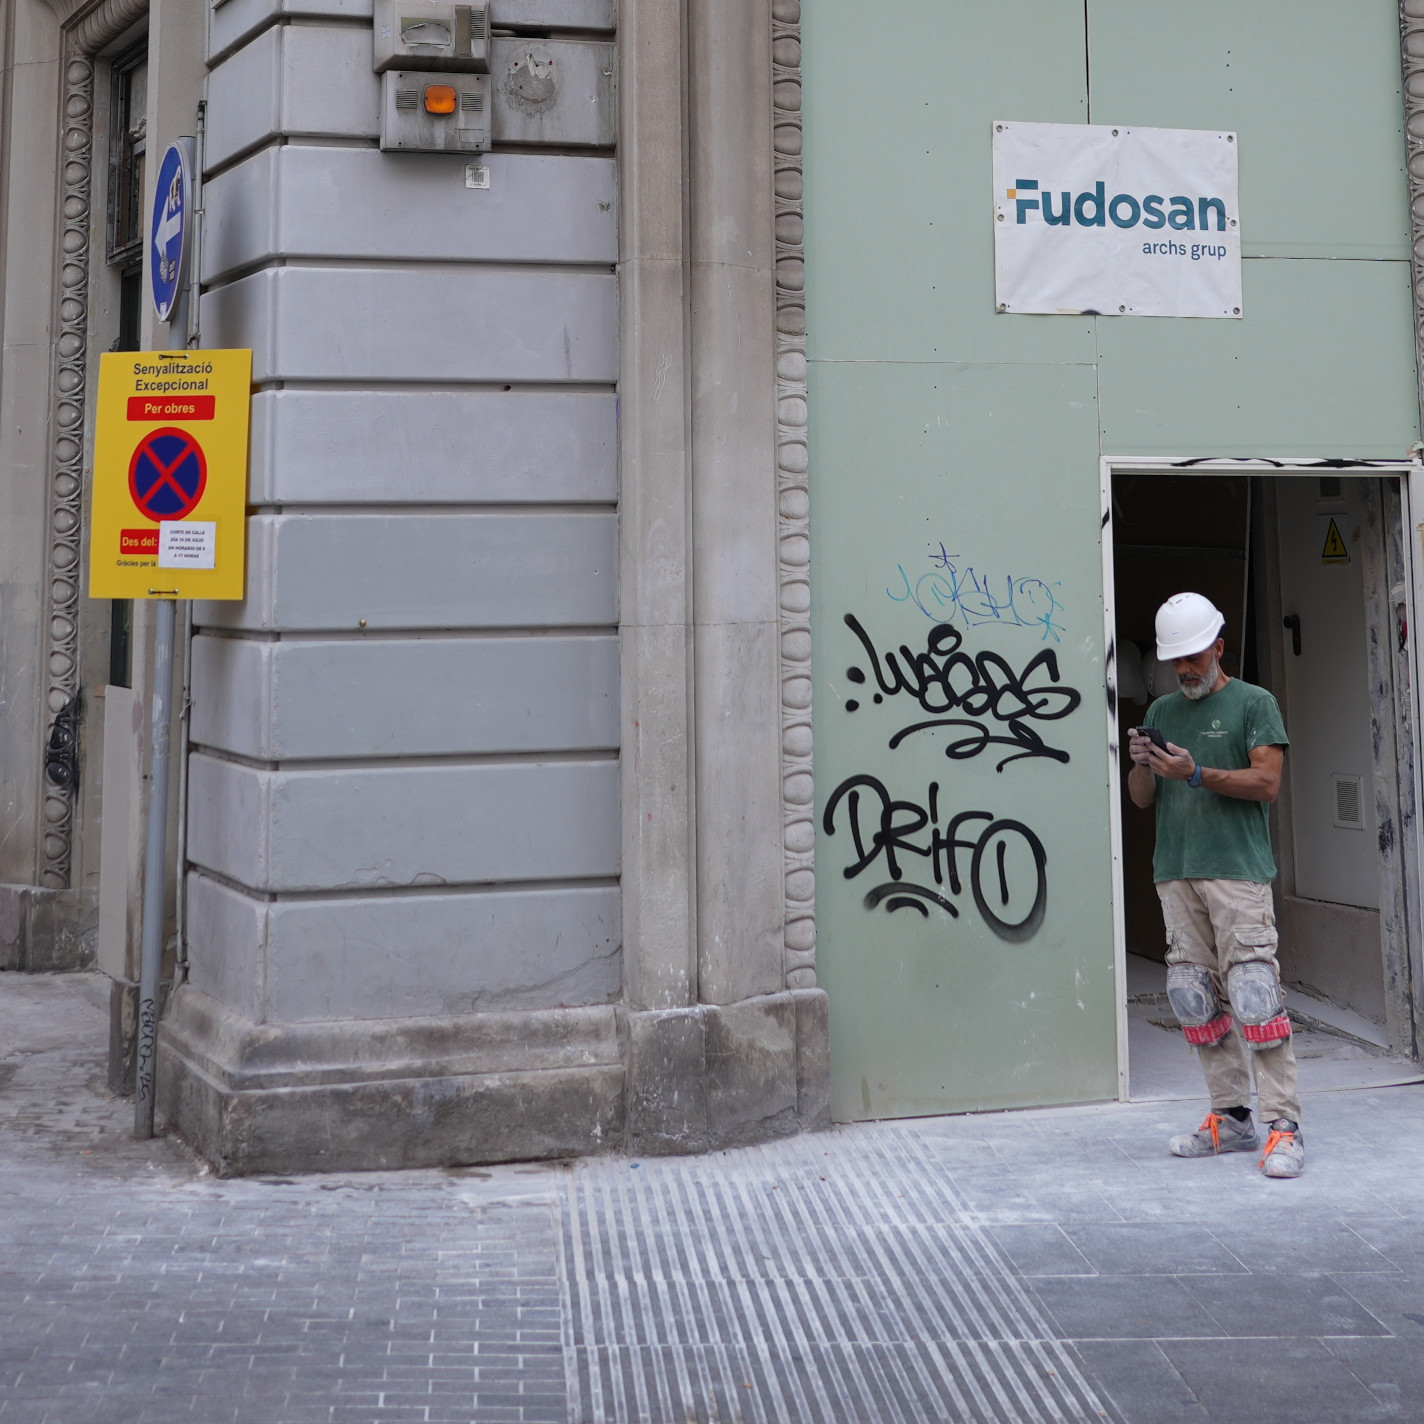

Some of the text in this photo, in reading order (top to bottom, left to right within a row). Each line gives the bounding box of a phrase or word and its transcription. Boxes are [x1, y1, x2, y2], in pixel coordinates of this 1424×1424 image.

[1007, 179, 1227, 231] Fudosan
[1142, 240, 1227, 260] archs grup
[134, 362, 213, 377] Senyalització
[136, 378, 208, 393] Excepcional
[144, 403, 196, 414] Per obres
[122, 536, 158, 546] Des del:
